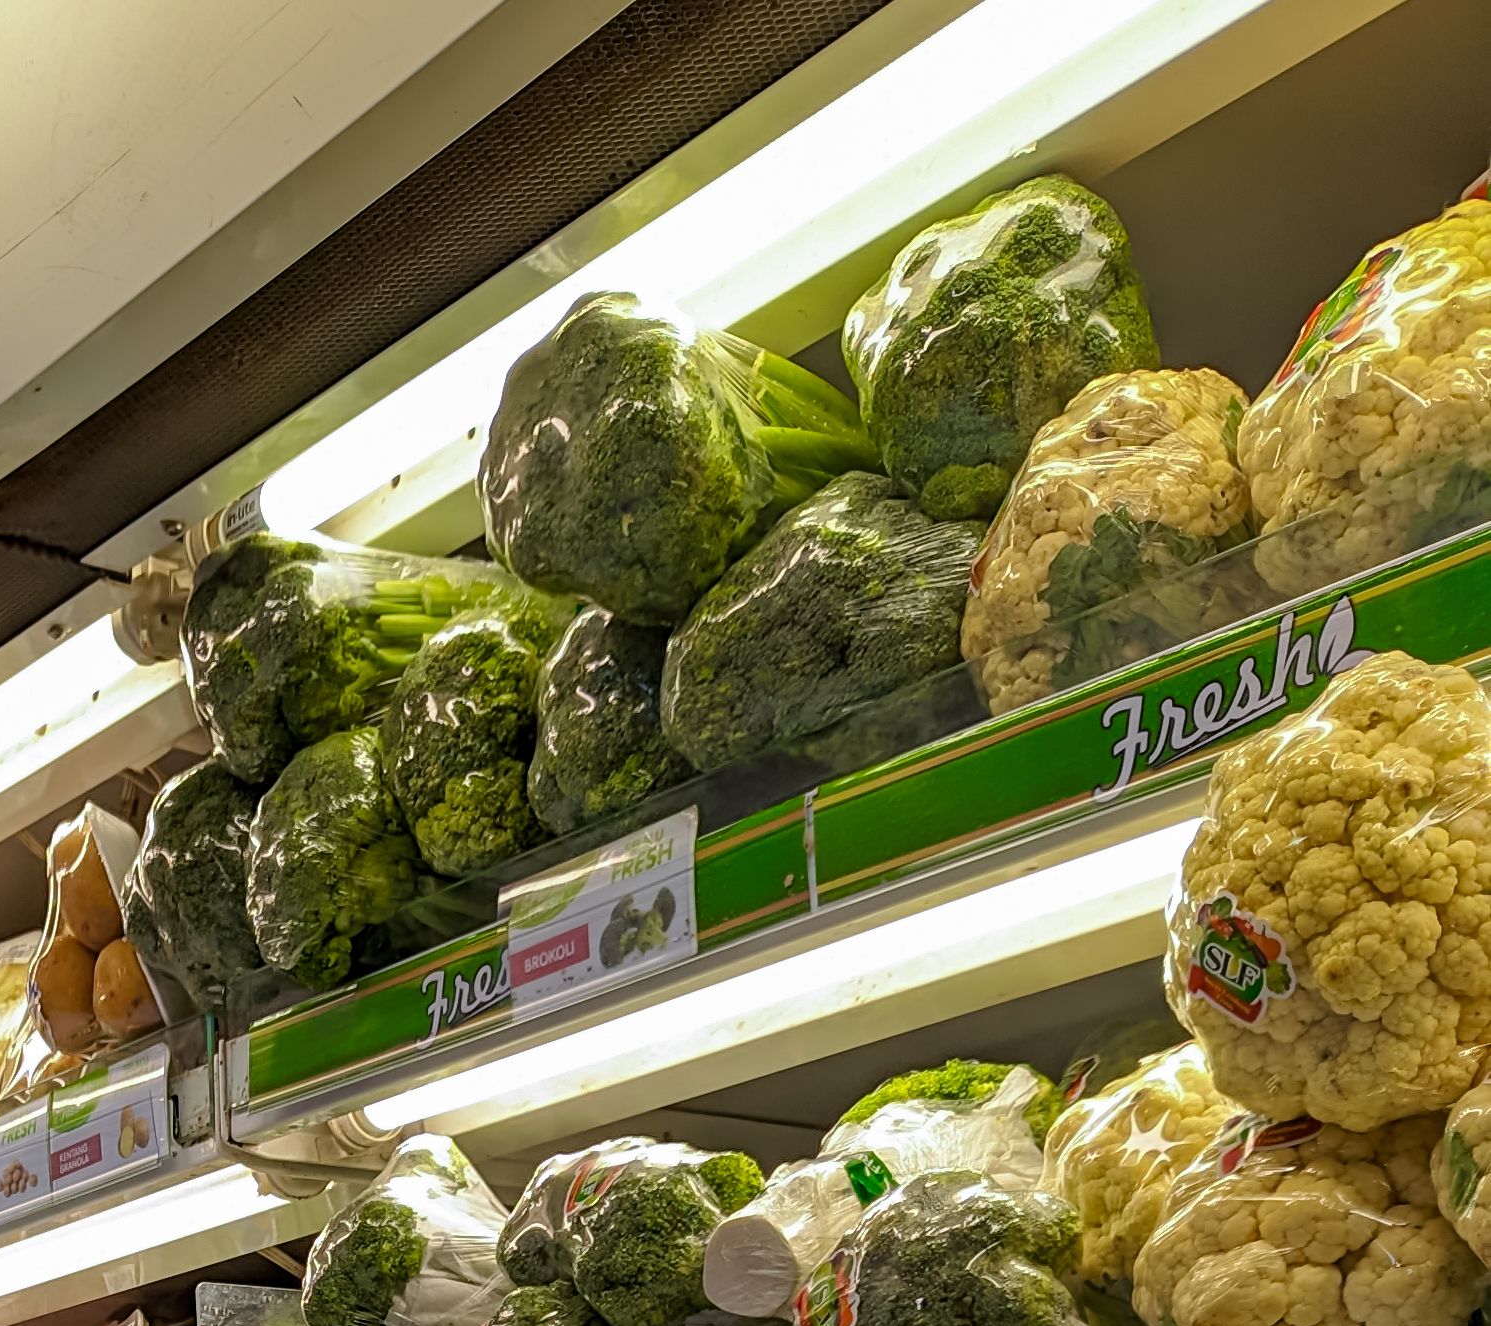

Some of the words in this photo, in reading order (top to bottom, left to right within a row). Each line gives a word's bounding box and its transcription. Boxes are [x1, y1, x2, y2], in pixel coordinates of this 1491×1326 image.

[1092, 610, 1315, 801] Fresh
[611, 838, 673, 884] FRESH
[415, 946, 509, 1050] Fres
[1205, 943, 1260, 991] SLF
